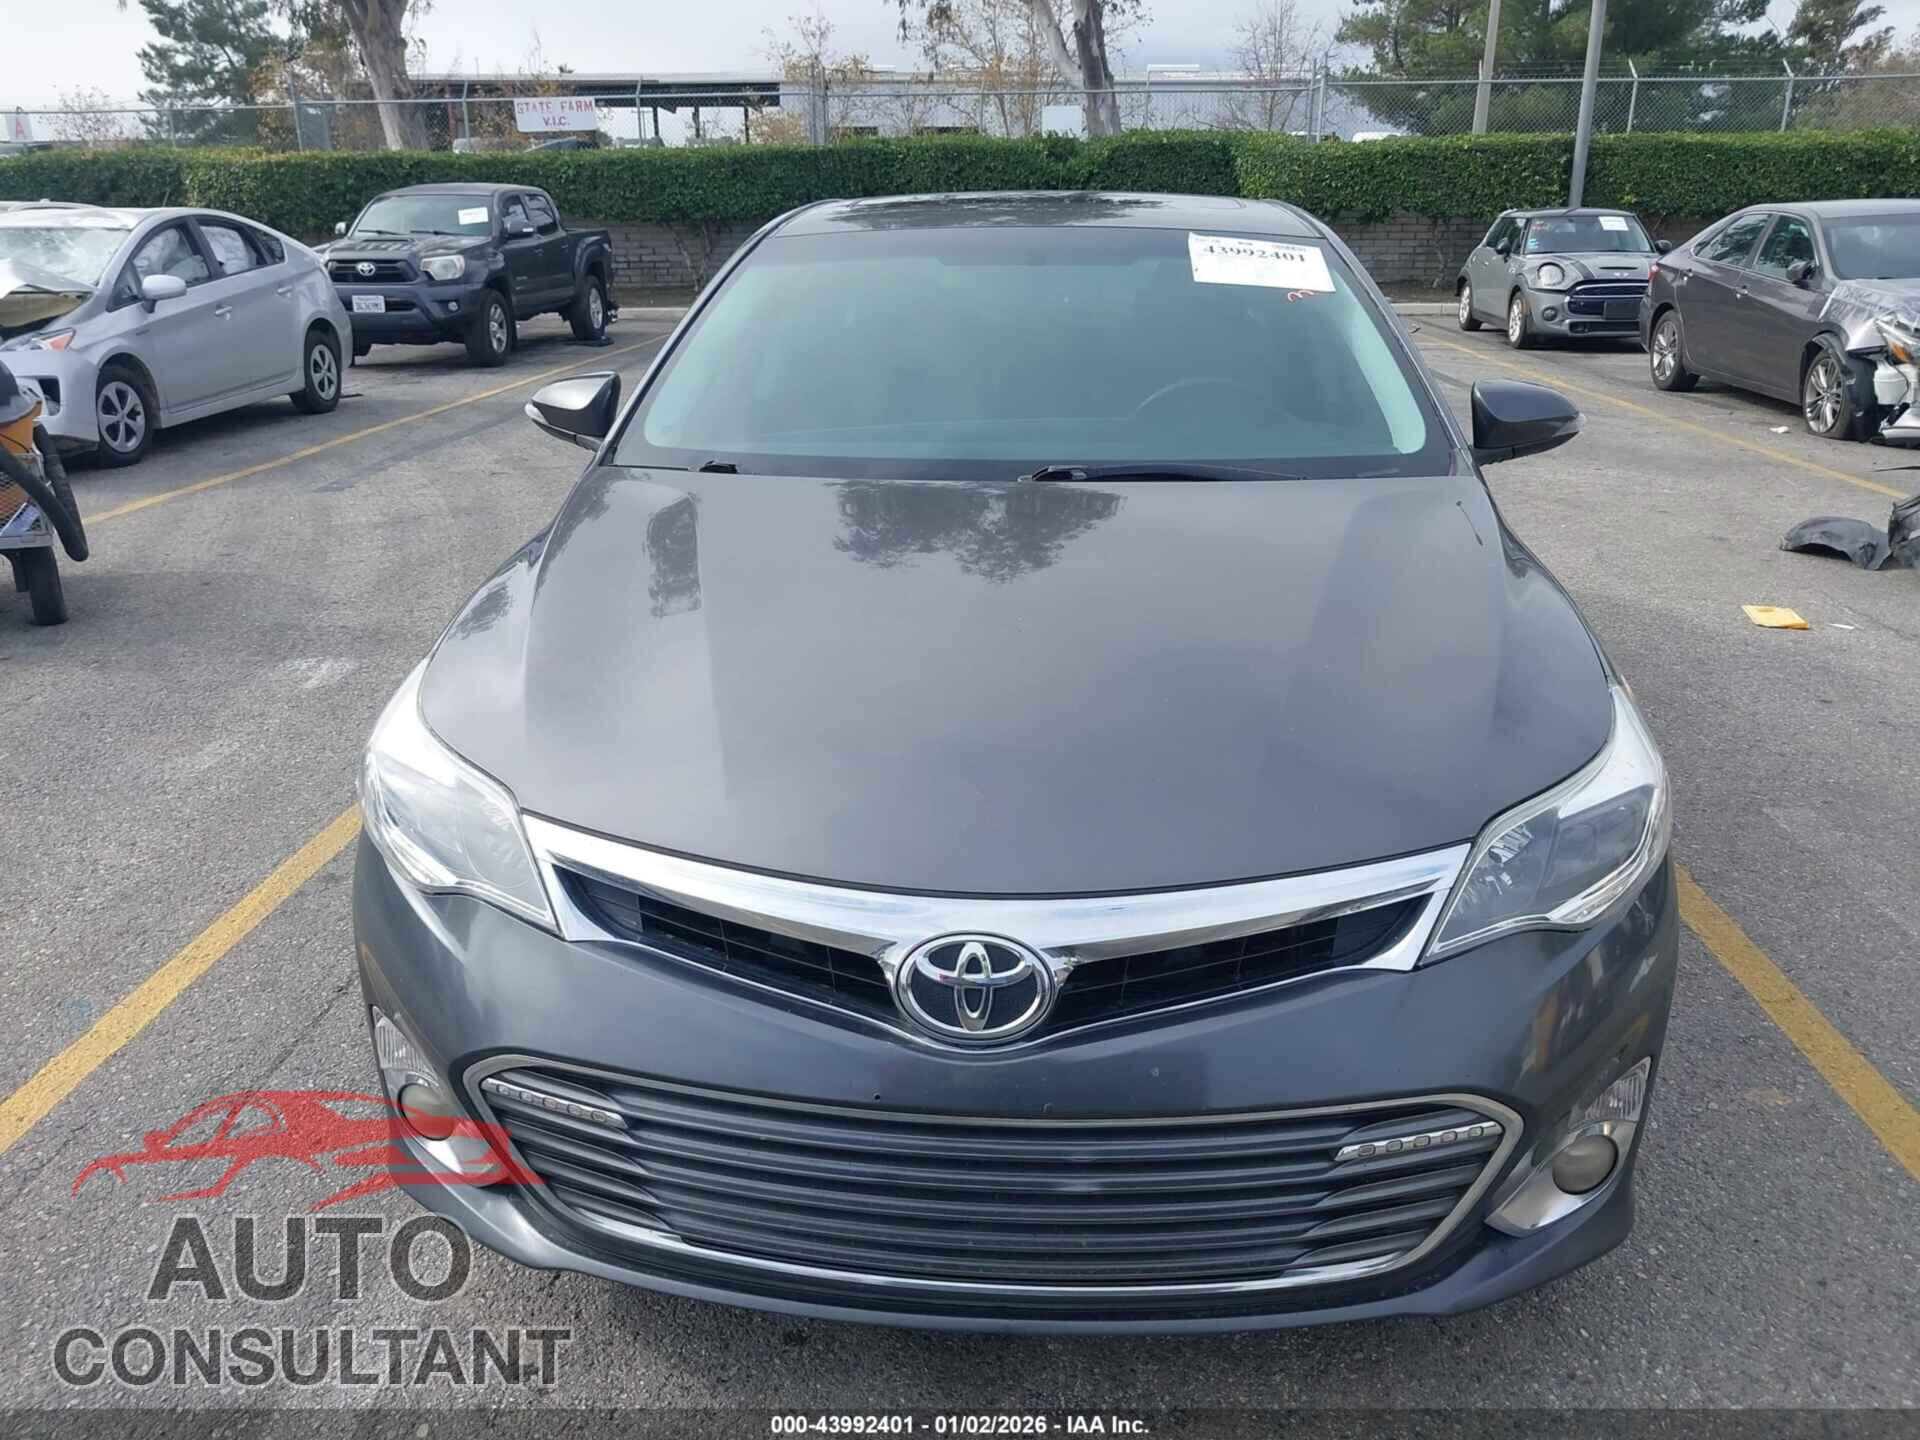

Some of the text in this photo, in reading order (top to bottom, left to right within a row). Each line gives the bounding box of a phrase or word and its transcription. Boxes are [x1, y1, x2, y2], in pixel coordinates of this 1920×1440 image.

[517, 100, 593, 113] STATE FARM
[1203, 245, 1306, 262] 43992401
